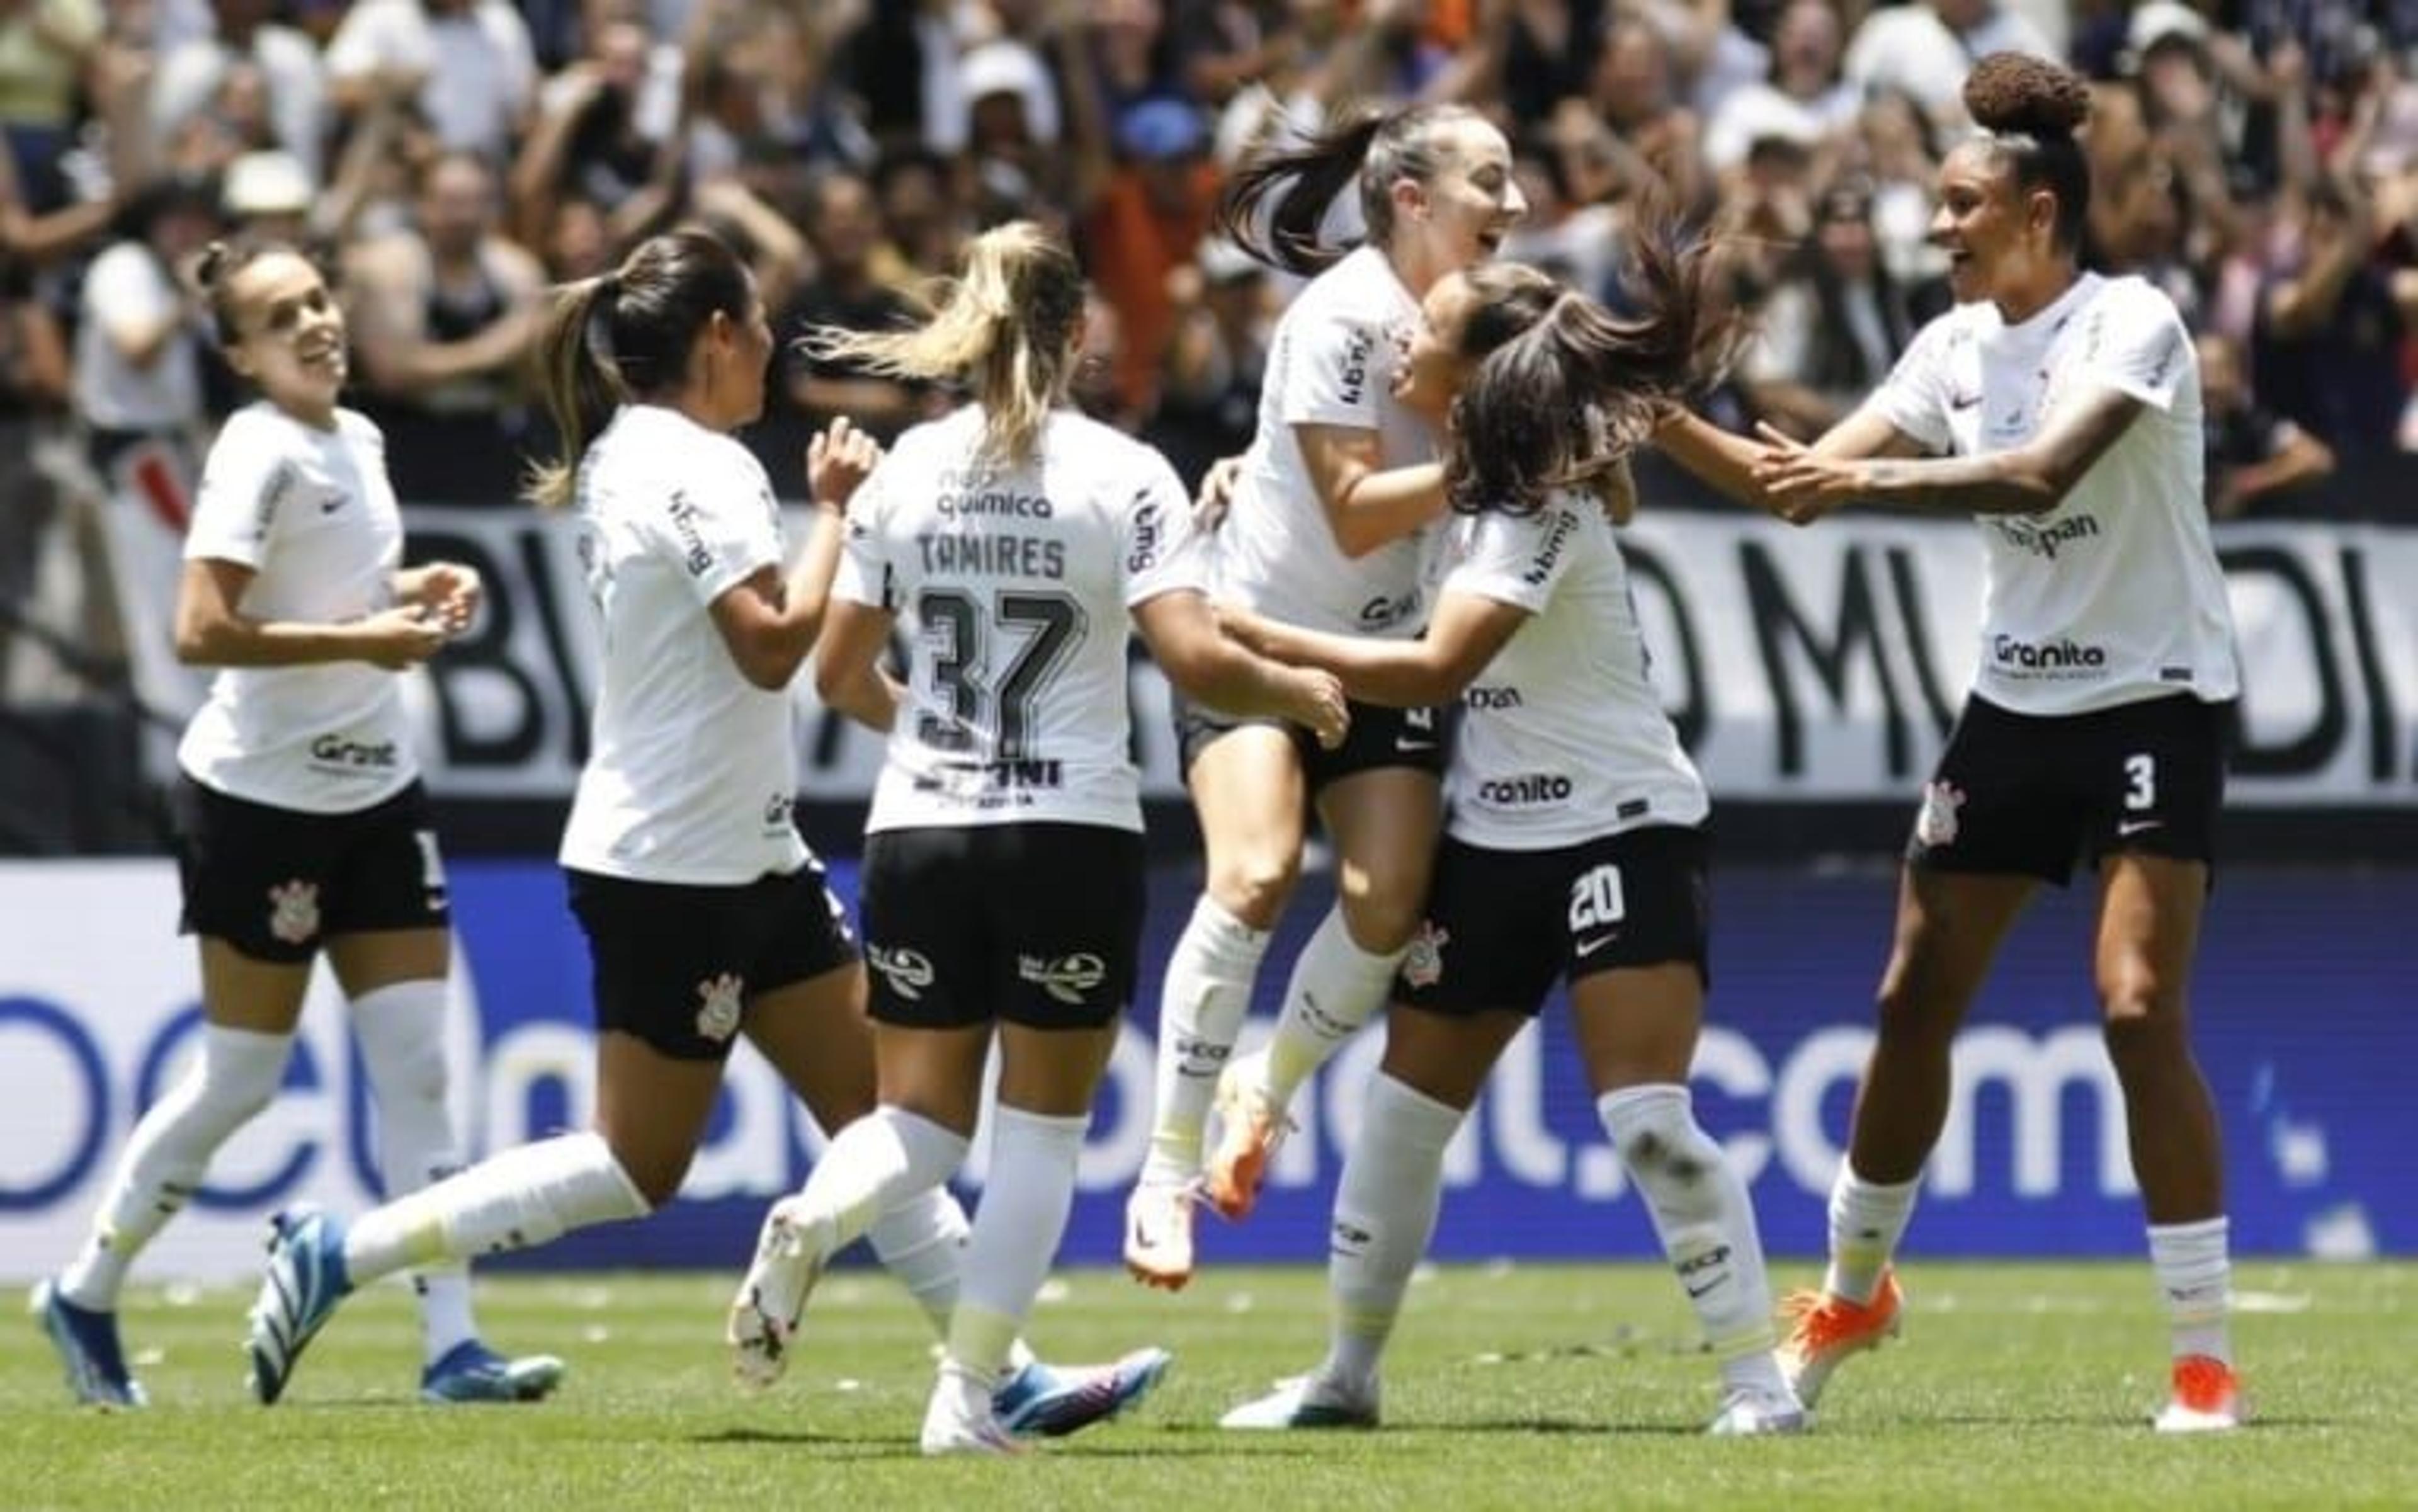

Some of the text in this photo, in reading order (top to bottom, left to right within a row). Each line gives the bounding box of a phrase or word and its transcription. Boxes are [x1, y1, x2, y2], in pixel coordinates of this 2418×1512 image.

[916, 533, 1066, 580] TAMIRES
[914, 587, 1091, 760] 37
[1994, 634, 2106, 668] Granito
[2126, 755, 2155, 810] 3
[1569, 864, 1626, 931] 20
